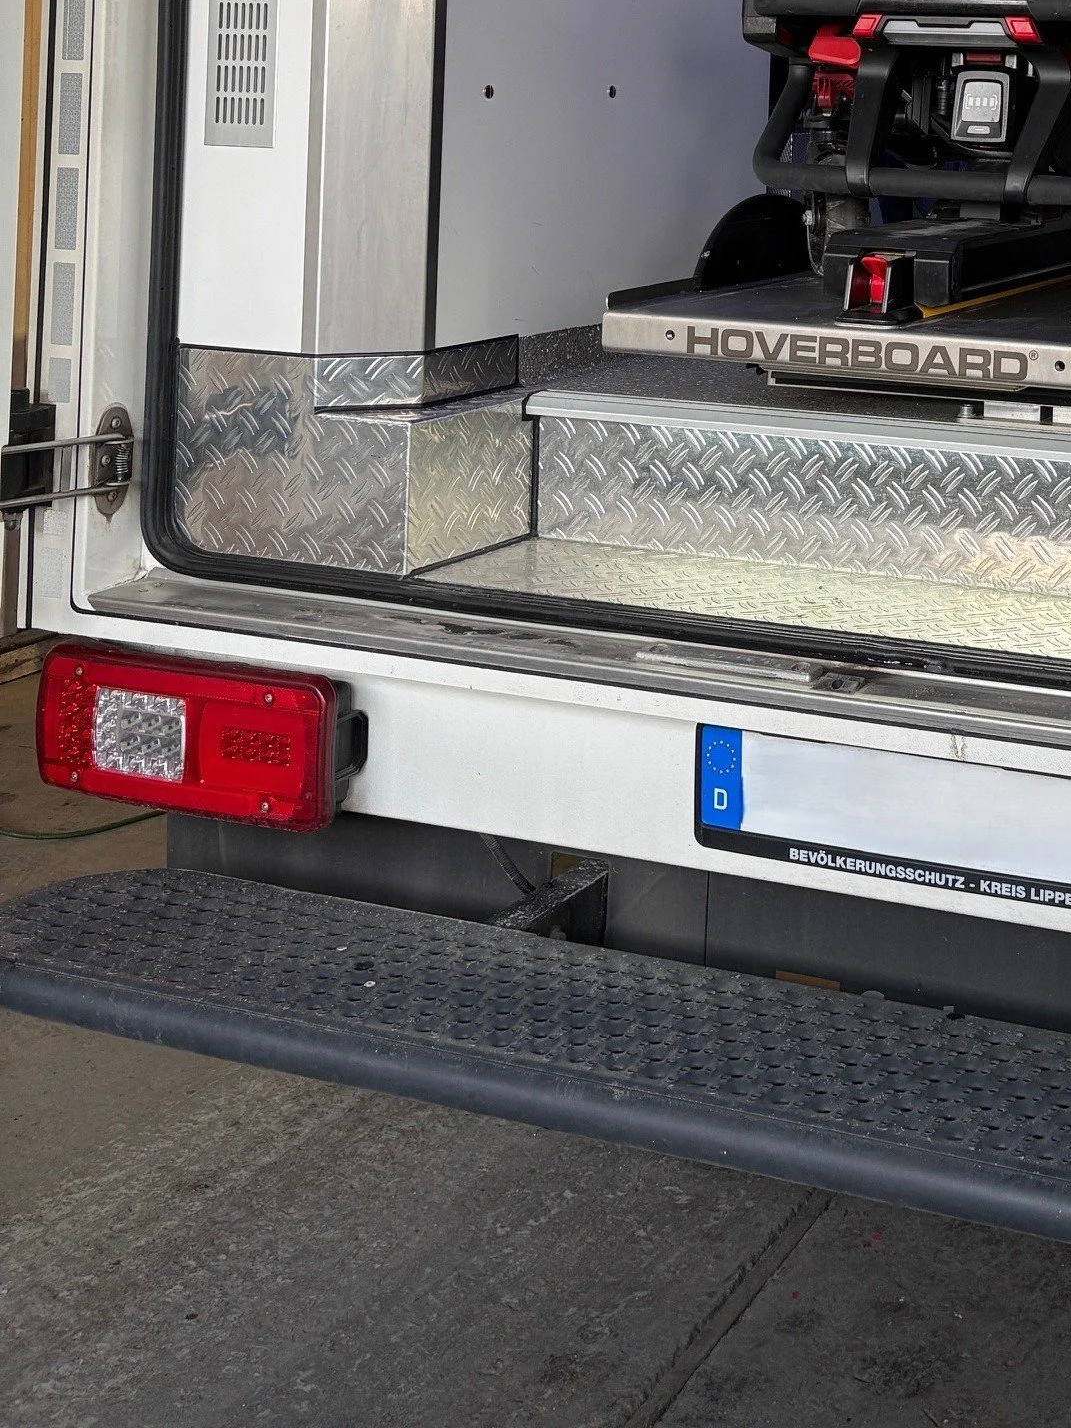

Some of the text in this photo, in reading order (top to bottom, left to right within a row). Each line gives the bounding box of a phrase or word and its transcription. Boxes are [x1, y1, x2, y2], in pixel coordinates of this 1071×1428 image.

[713, 787, 728, 811] D
[789, 847, 965, 889] BEVÖLKERUNGSSCHUTZ
[979, 879, 1026, 899] KREIS
